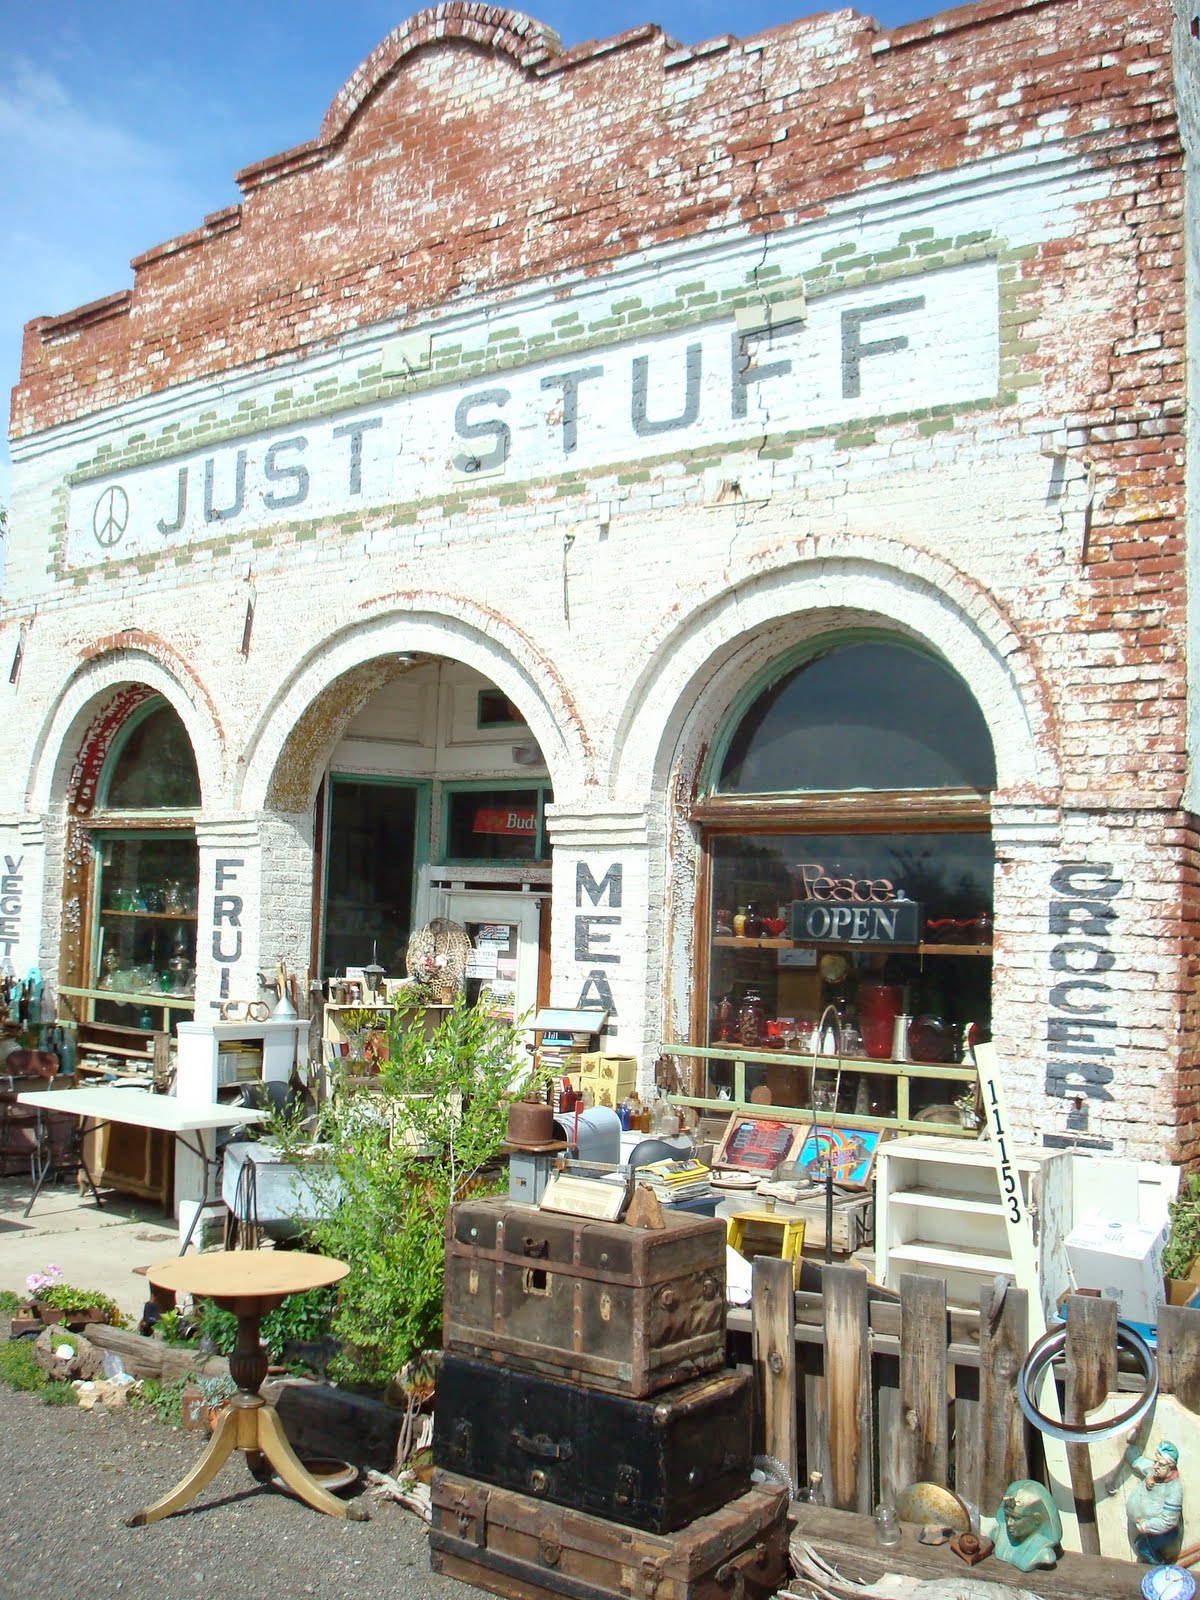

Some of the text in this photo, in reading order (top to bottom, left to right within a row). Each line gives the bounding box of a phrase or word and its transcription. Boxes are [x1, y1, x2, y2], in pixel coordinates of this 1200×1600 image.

[157, 295, 926, 536] JUST STUFF
[210, 859, 245, 1021] FRUIT
[574, 862, 623, 1036] MEA
[796, 864, 896, 902] Peace
[806, 906, 900, 941] OPEN
[988, 1079, 1021, 1224] 11153
